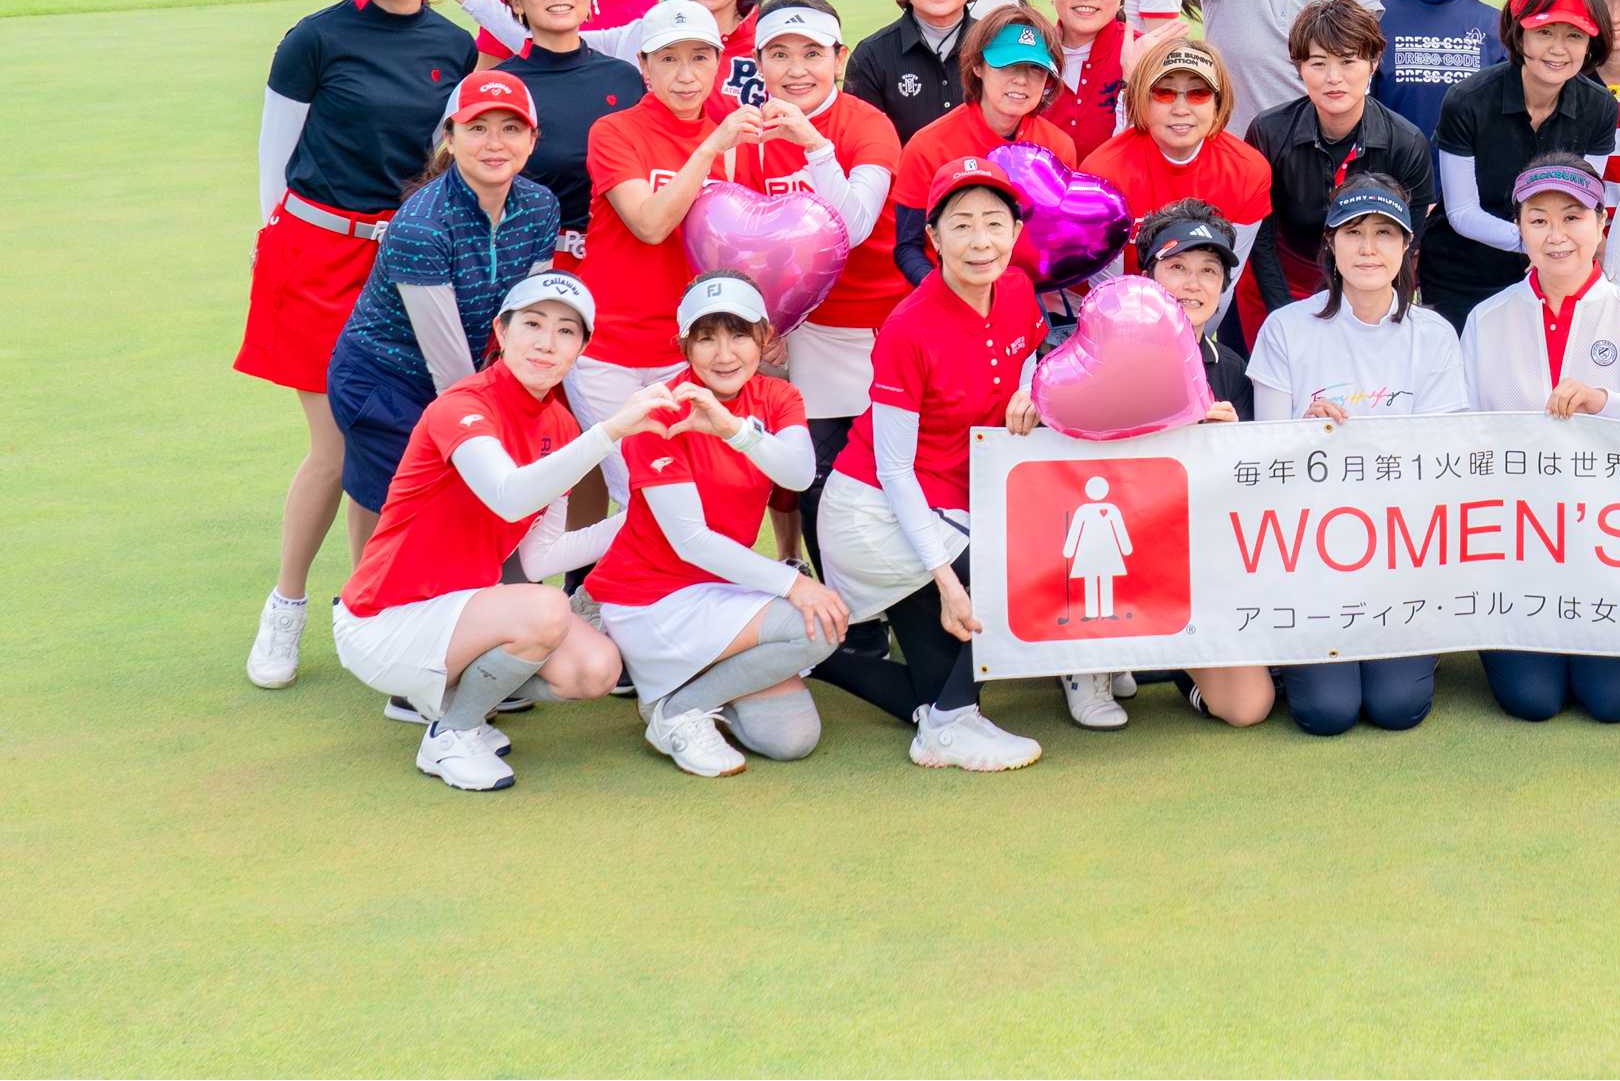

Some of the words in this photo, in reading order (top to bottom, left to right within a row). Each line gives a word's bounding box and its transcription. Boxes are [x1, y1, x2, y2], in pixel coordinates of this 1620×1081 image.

[1339, 195, 1368, 207] TOMMY
[543, 278, 580, 297] Callaway
[706, 282, 722, 298] FJ
